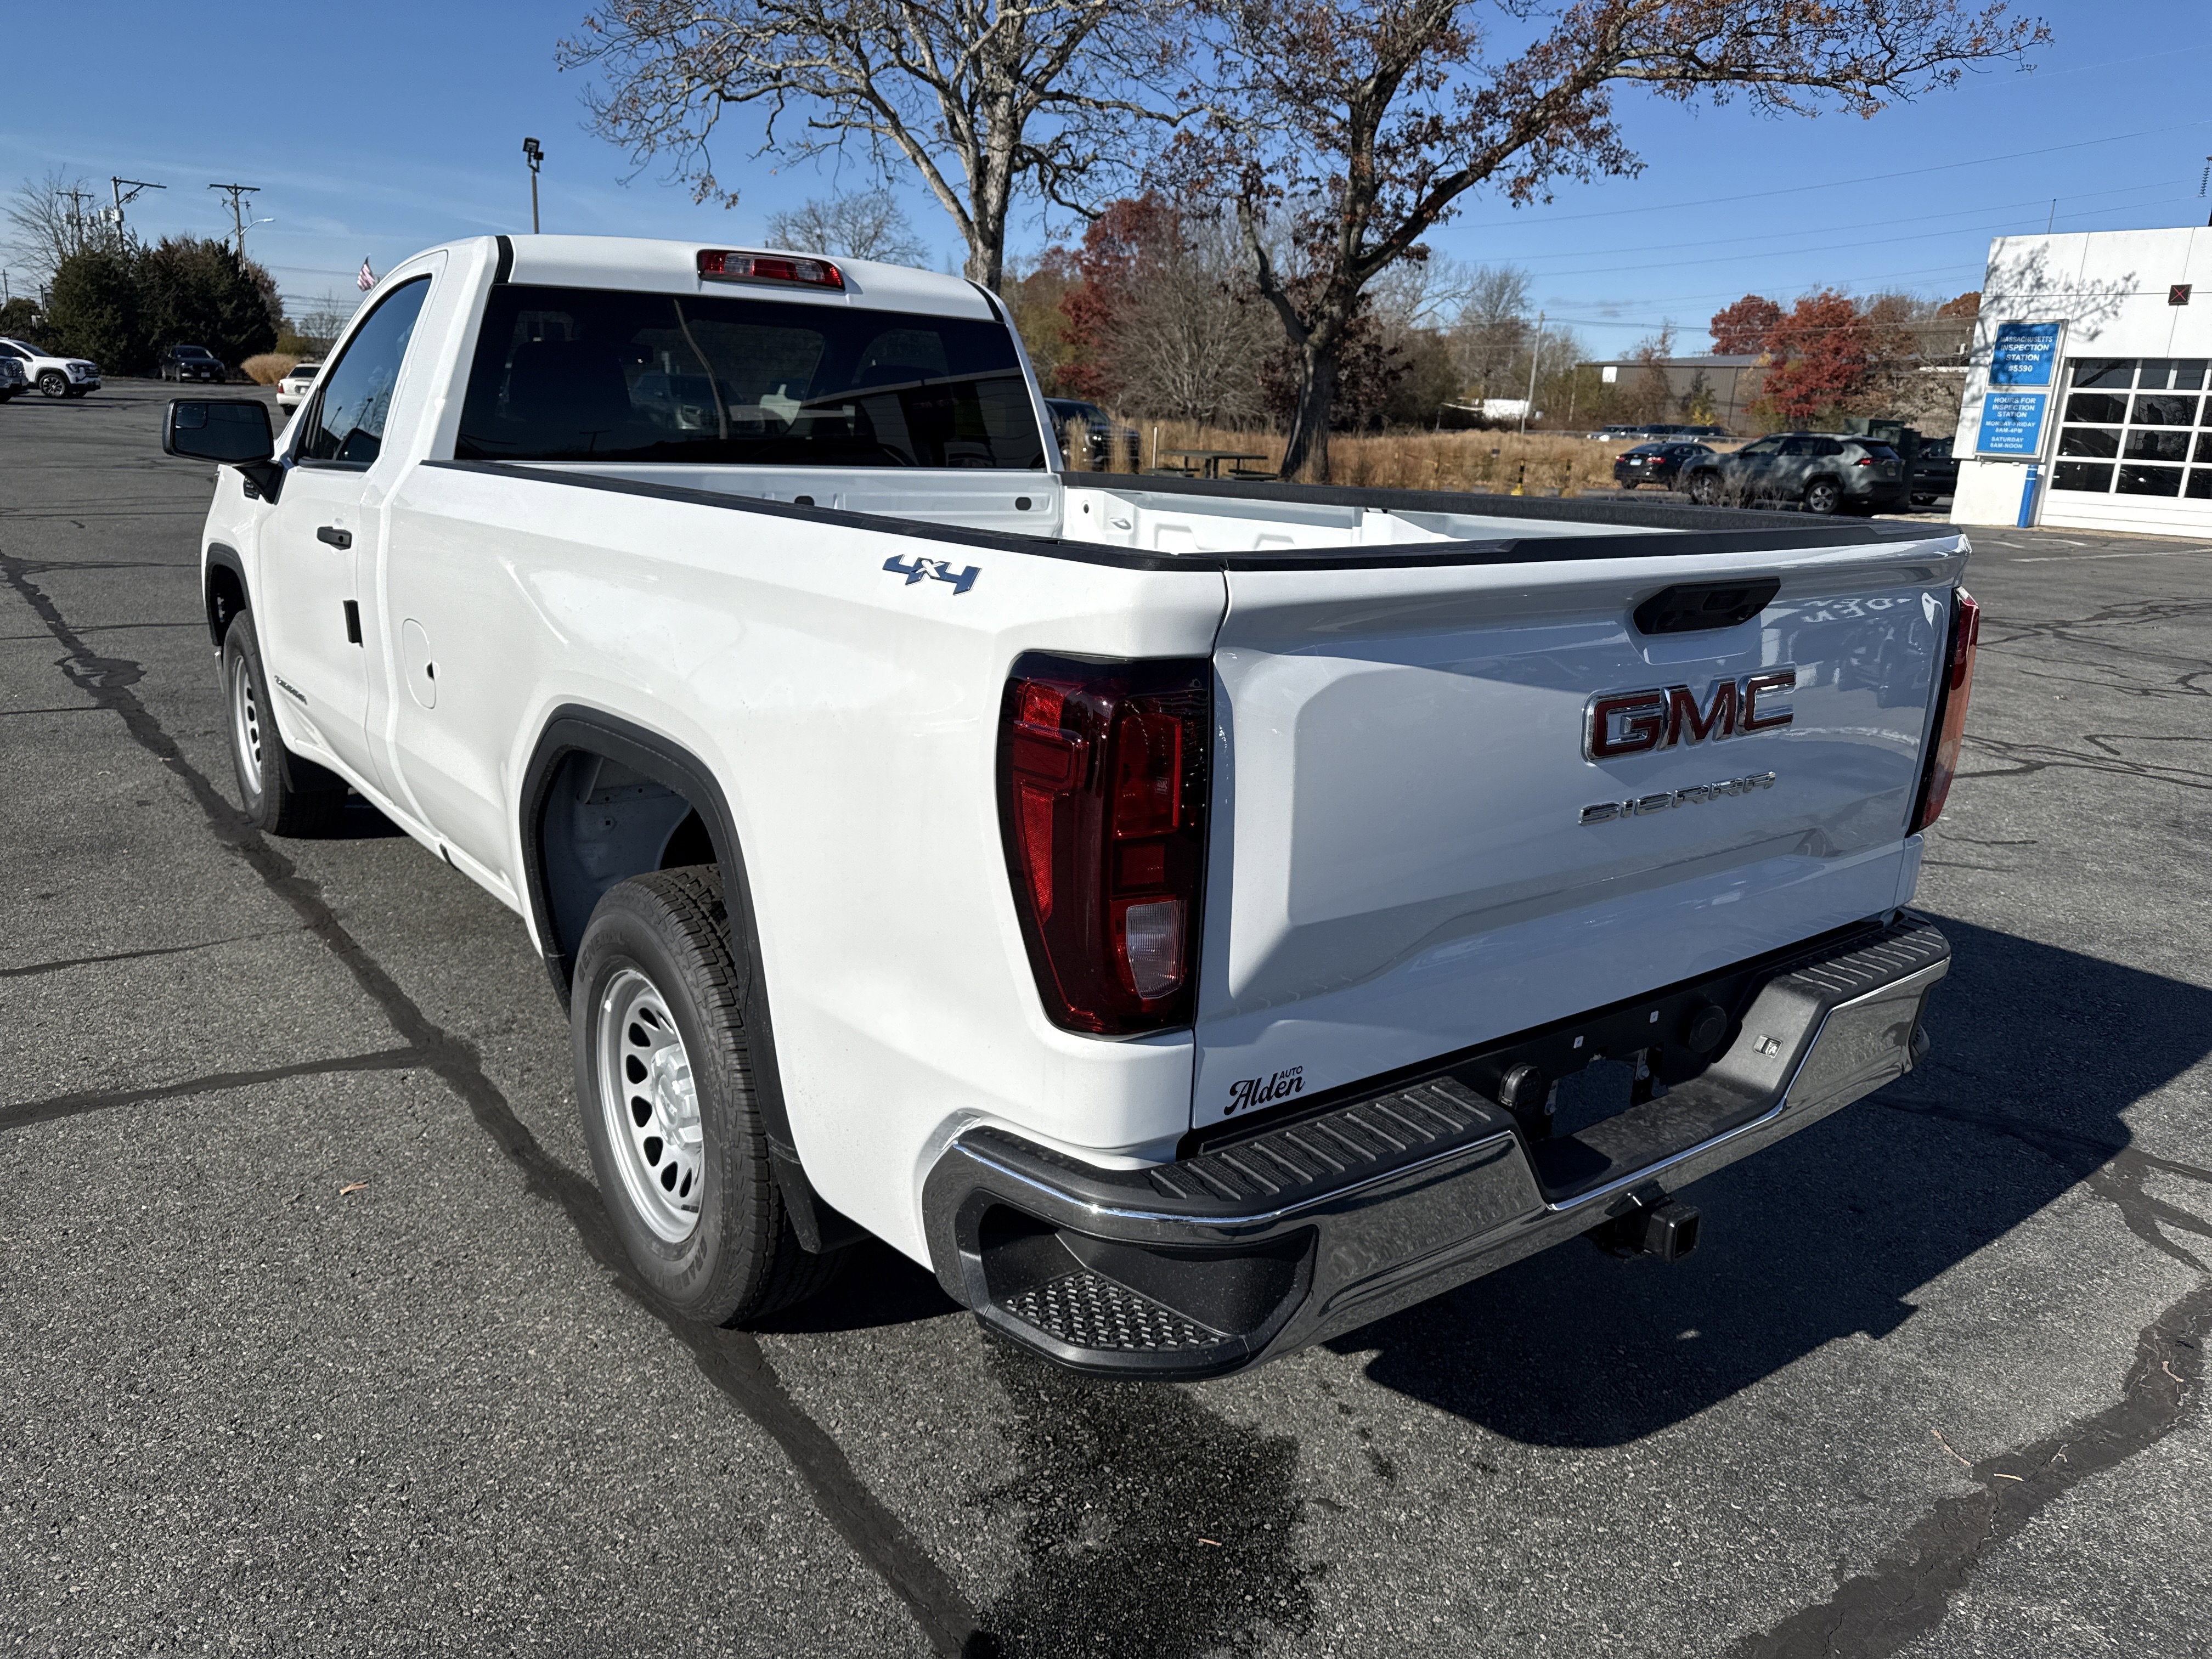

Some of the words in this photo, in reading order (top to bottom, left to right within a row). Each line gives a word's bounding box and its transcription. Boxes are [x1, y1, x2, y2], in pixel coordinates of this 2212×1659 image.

[1581, 667, 1796, 763] GMC
[1578, 771, 1776, 825] SIERRA
[1223, 1073, 1305, 1115] Alden
[1279, 1065, 1303, 1080] AUTO
